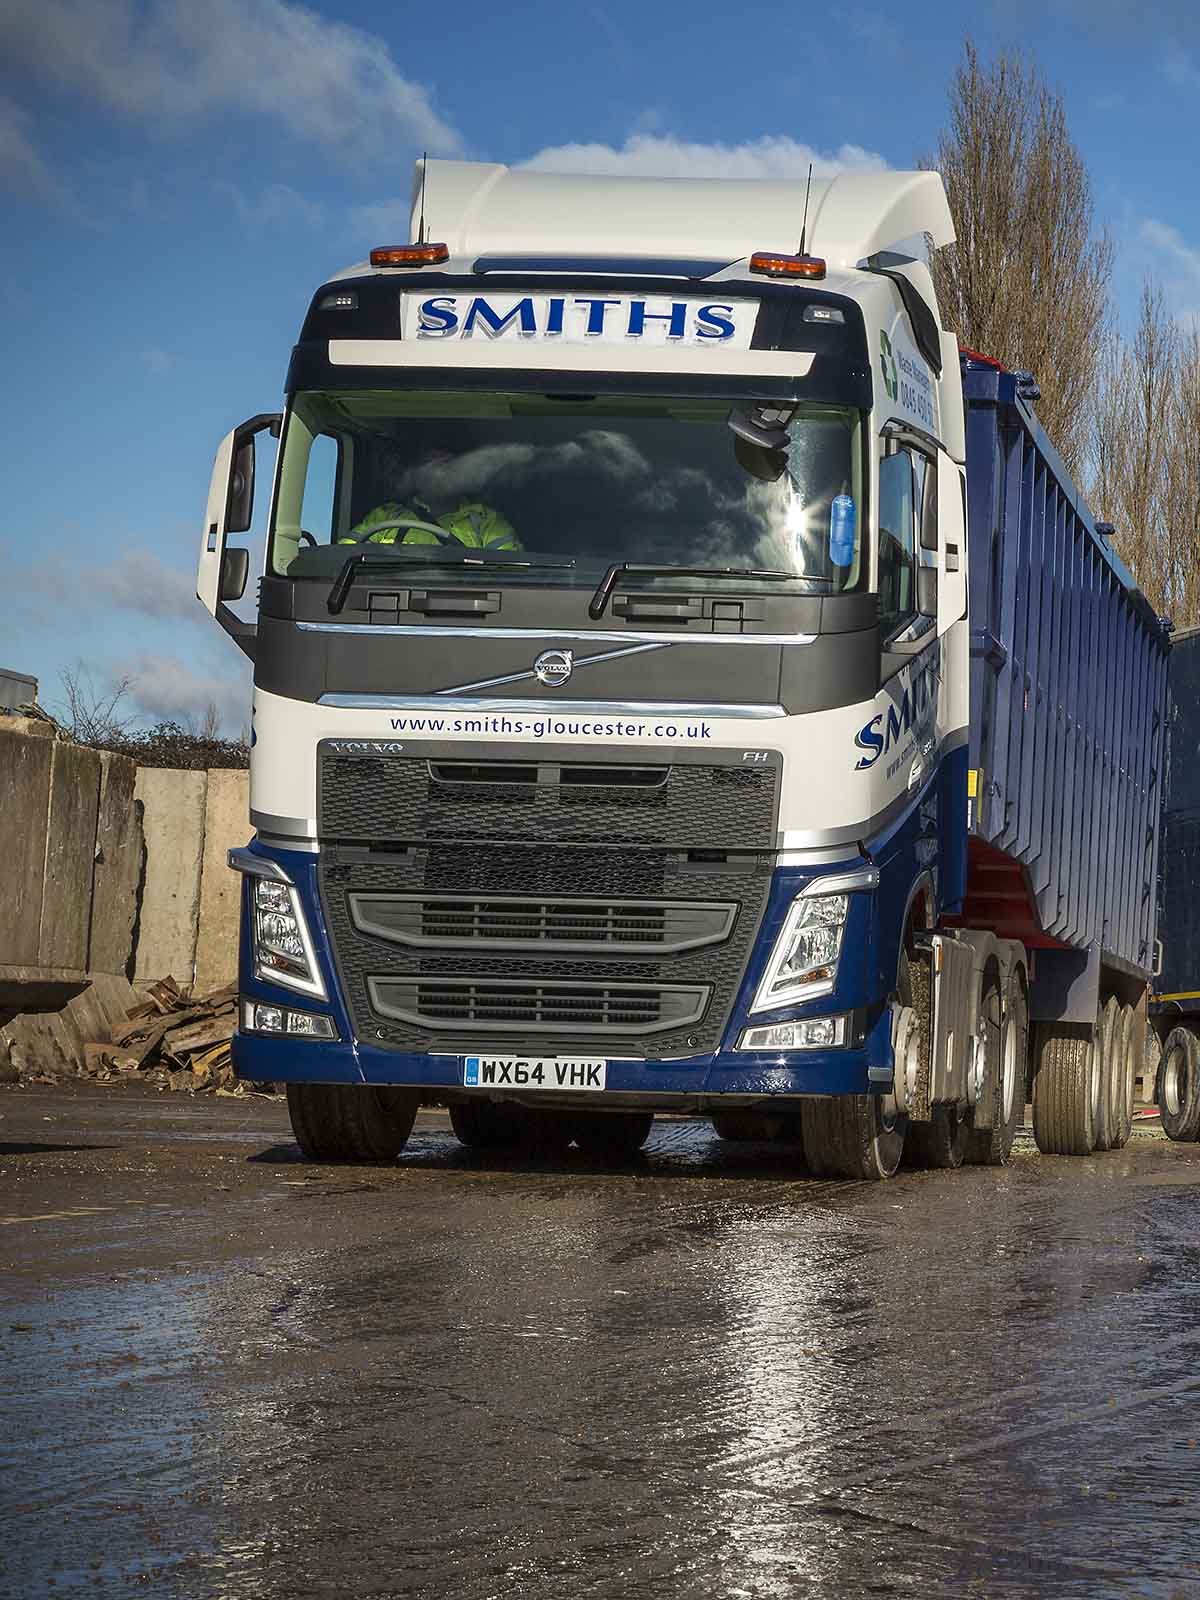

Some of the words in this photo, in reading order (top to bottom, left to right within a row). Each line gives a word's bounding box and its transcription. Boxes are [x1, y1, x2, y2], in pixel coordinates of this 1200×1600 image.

[418, 297, 736, 340] SMITHS
[390, 716, 711, 739] www.smiths-gloucester.co.uk
[742, 751, 768, 762] FH
[481, 1060, 545, 1085] WX64
[554, 1062, 602, 1087] VHK
